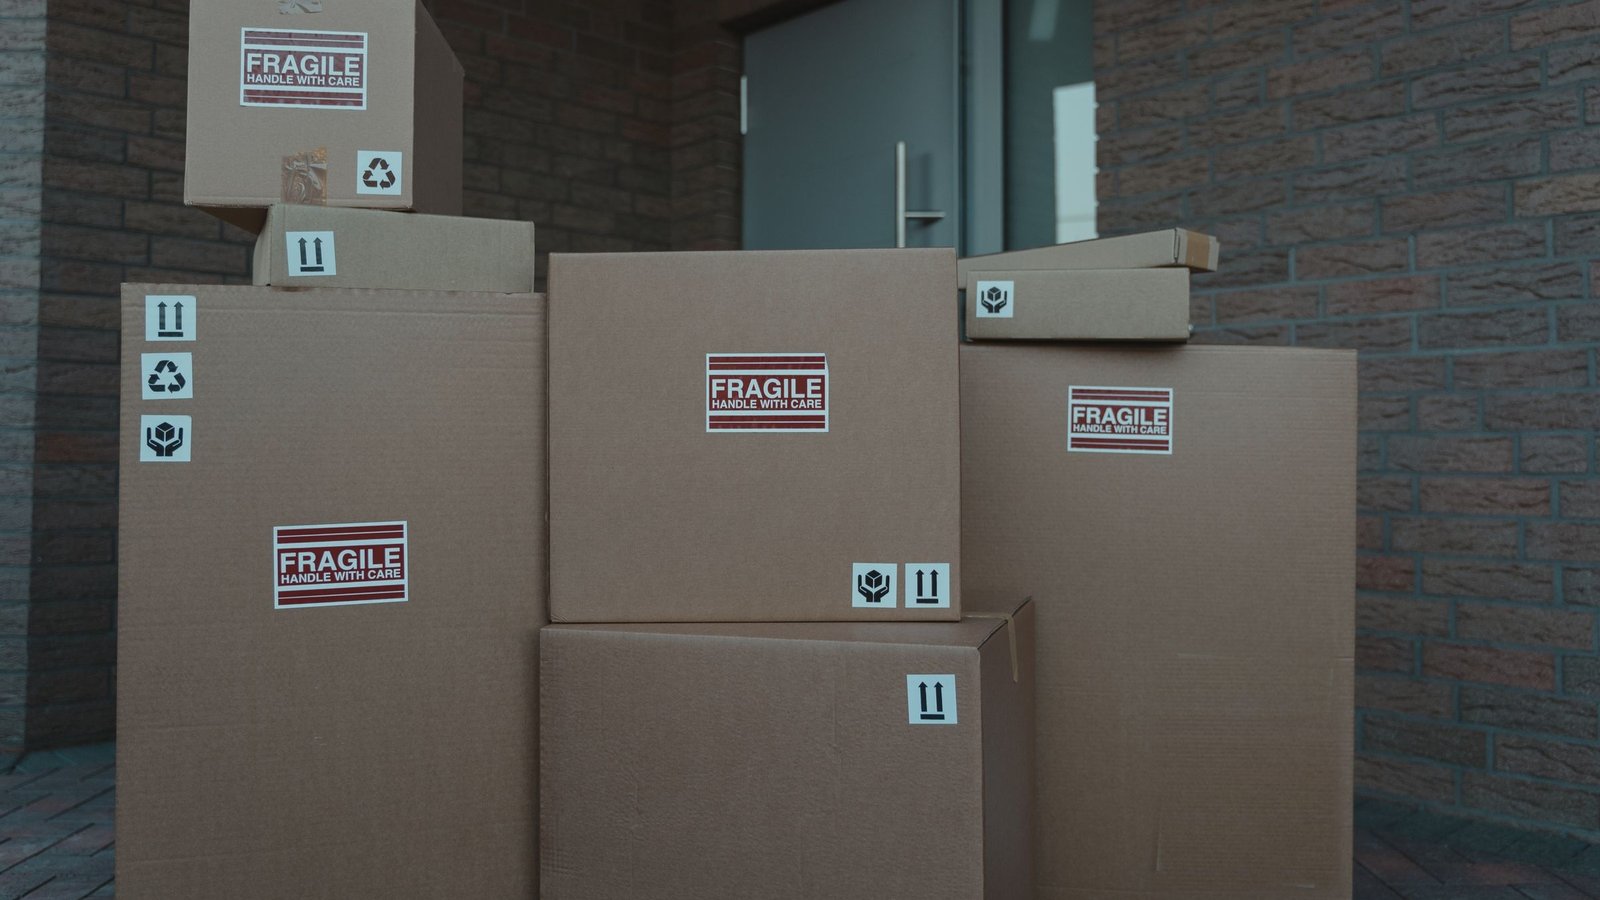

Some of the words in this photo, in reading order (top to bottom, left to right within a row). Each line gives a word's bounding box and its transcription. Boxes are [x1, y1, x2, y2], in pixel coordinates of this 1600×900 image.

[247, 53, 360, 76] FRAGILE
[247, 74, 293, 84] HANDLE
[297, 76, 325, 85] WITH
[328, 76, 360, 86] CARE
[712, 379, 822, 398] FRAGILE
[712, 400, 757, 408] HANDLE
[760, 400, 787, 408] WITH
[791, 400, 821, 408] CARE
[1073, 407, 1167, 425] FRAGILE
[1073, 424, 1112, 433] HANDLE
[1114, 425, 1138, 433] WITH
[1140, 426, 1167, 434] CARE
[281, 548, 400, 572] FRAGILE
[281, 572, 331, 584] HANDLE
[334, 570, 364, 581] WITH
[368, 569, 401, 579] CARE
